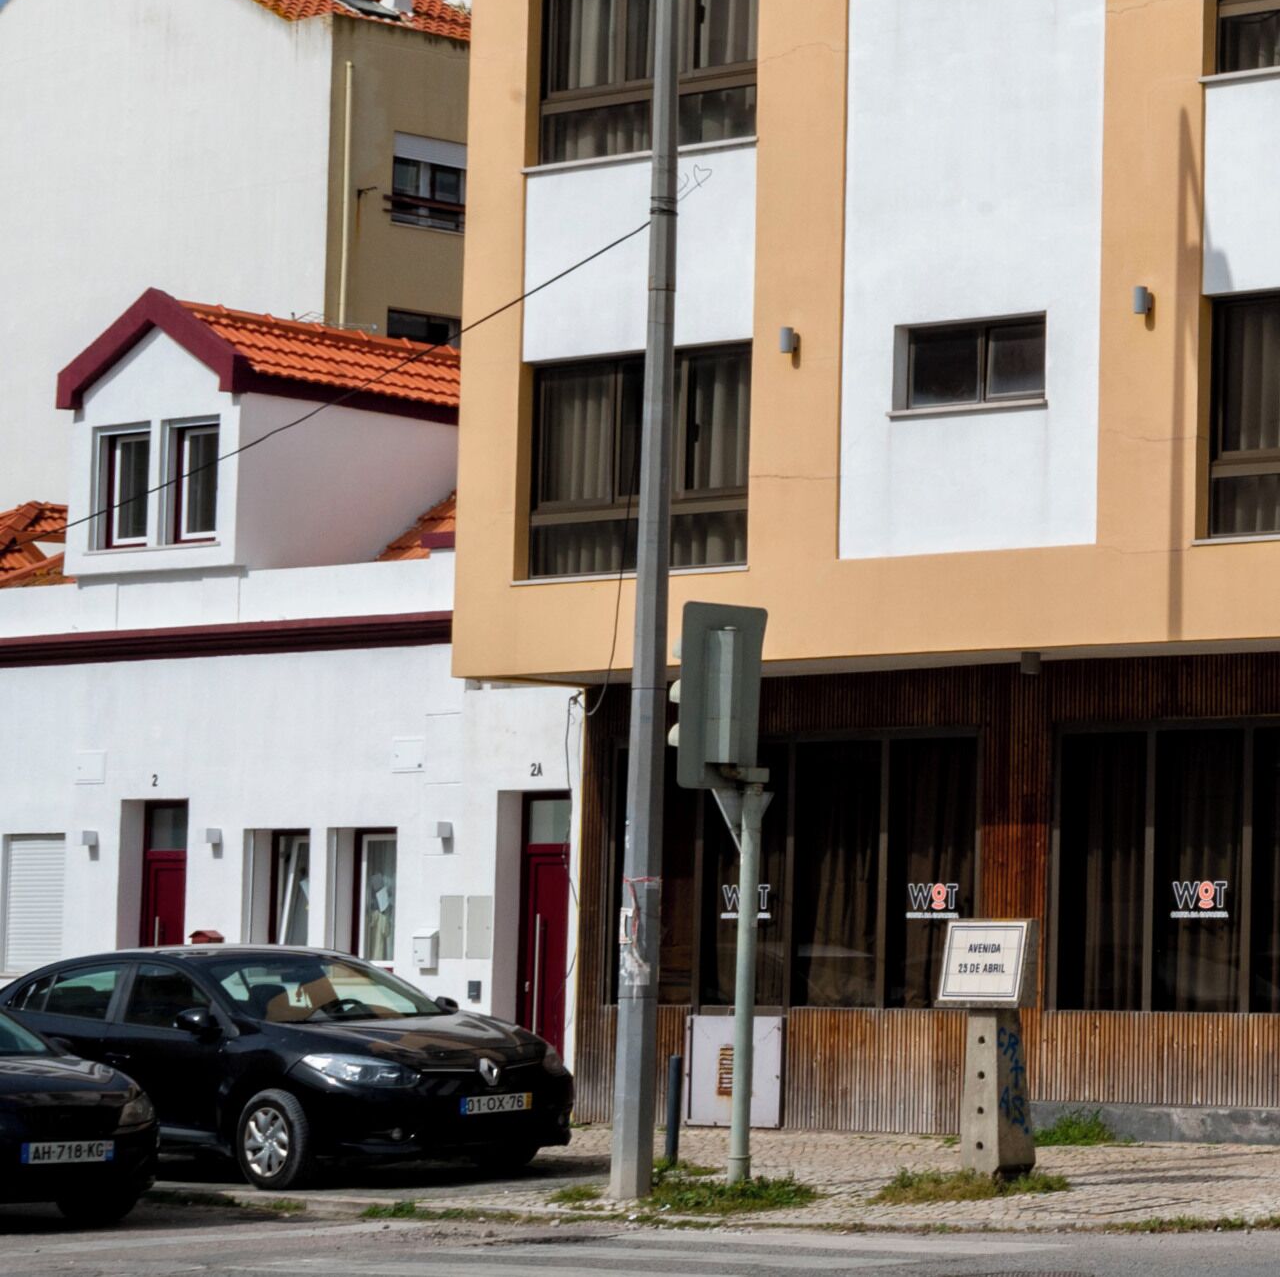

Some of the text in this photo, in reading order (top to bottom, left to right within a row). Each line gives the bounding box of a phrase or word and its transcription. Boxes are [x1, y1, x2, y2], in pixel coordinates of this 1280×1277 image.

[530, 762, 543, 777] 2A
[152, 774, 159, 788] 2
[722, 884, 771, 910] WT
[908, 883, 959, 910] WOT
[1172, 881, 1227, 910] WOT
[968, 943, 1001, 954] AVENIDA
[958, 963, 1005, 973] 25 DE ABRIL
[32, 1142, 105, 1161] AH-718-KG
